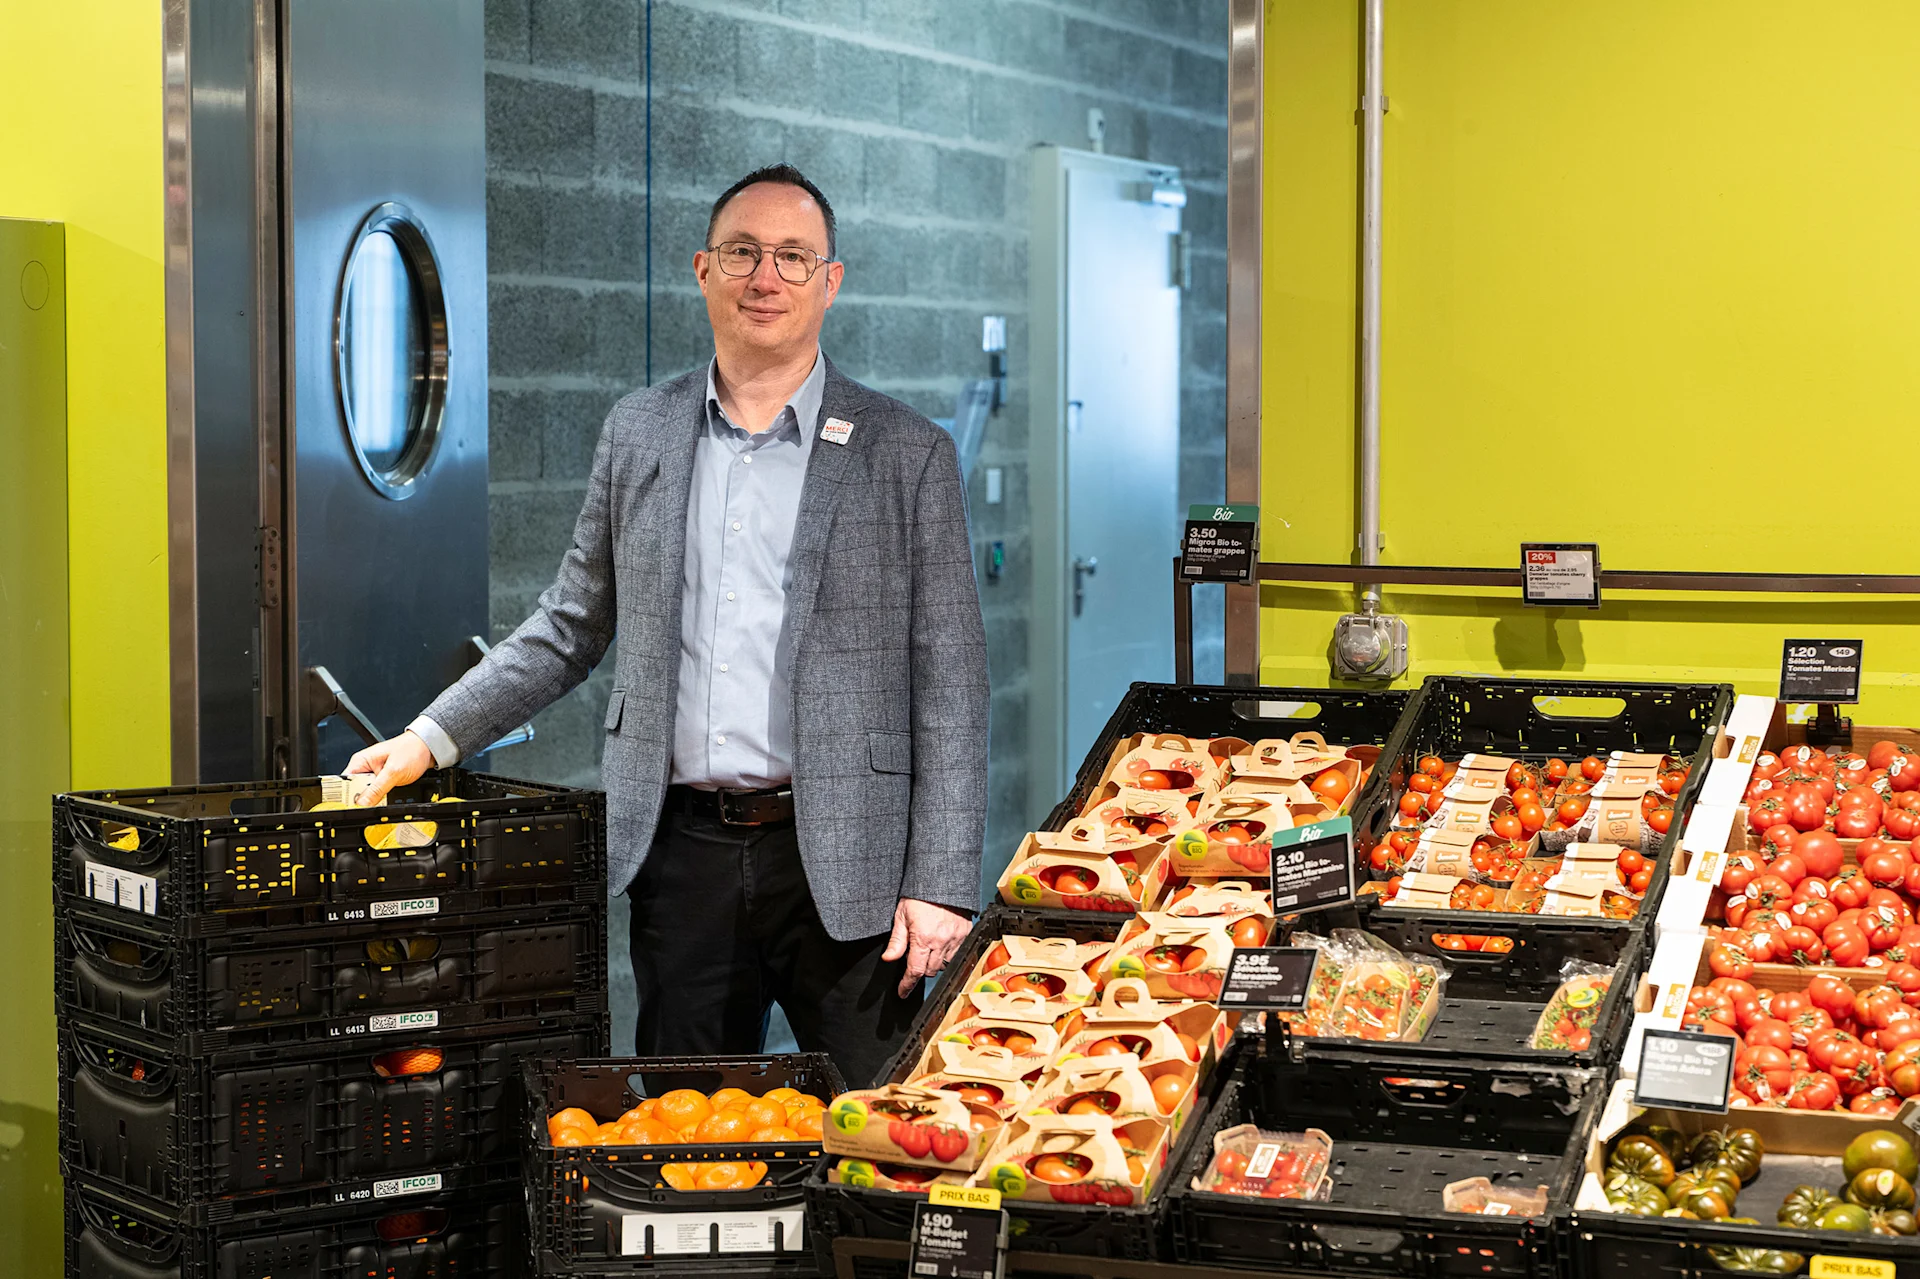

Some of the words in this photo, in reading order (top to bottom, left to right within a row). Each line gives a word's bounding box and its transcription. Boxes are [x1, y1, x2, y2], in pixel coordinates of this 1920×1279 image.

[1212, 508, 1234, 521] Bio
[1190, 528, 1216, 538] 3.50
[1189, 538, 1216, 546] Migros
[1789, 647, 1817, 657] 1.20
[1299, 826, 1324, 842] Bio
[1276, 851, 1304, 866] 2.10
[1277, 864, 1304, 874] Migros
[1305, 861, 1318, 869] Bio
[1278, 873, 1302, 882] mates
[1303, 864, 1344, 877] Marsanino
[401, 900, 424, 910] IFCO
[328, 912, 339, 920] LL
[344, 910, 365, 919] 6413
[1235, 954, 1270, 965] 3.95
[1231, 973, 1283, 981] Marsanino
[400, 1014, 423, 1024] IFCO
[330, 1027, 340, 1036] LL
[345, 1025, 365, 1034] 6413
[1647, 1039, 1678, 1053] 1.10
[403, 1178, 426, 1188] IFCO
[350, 1190, 370, 1199] 6420
[940, 1190, 965, 1201] PRIX
[968, 1193, 990, 1204] BAS
[922, 1212, 953, 1228] 1.90
[921, 1226, 968, 1239] M-Budget
[920, 1236, 963, 1249] Tomates
[1822, 1262, 1851, 1274] PRIX
[1856, 1264, 1883, 1277] BAS
